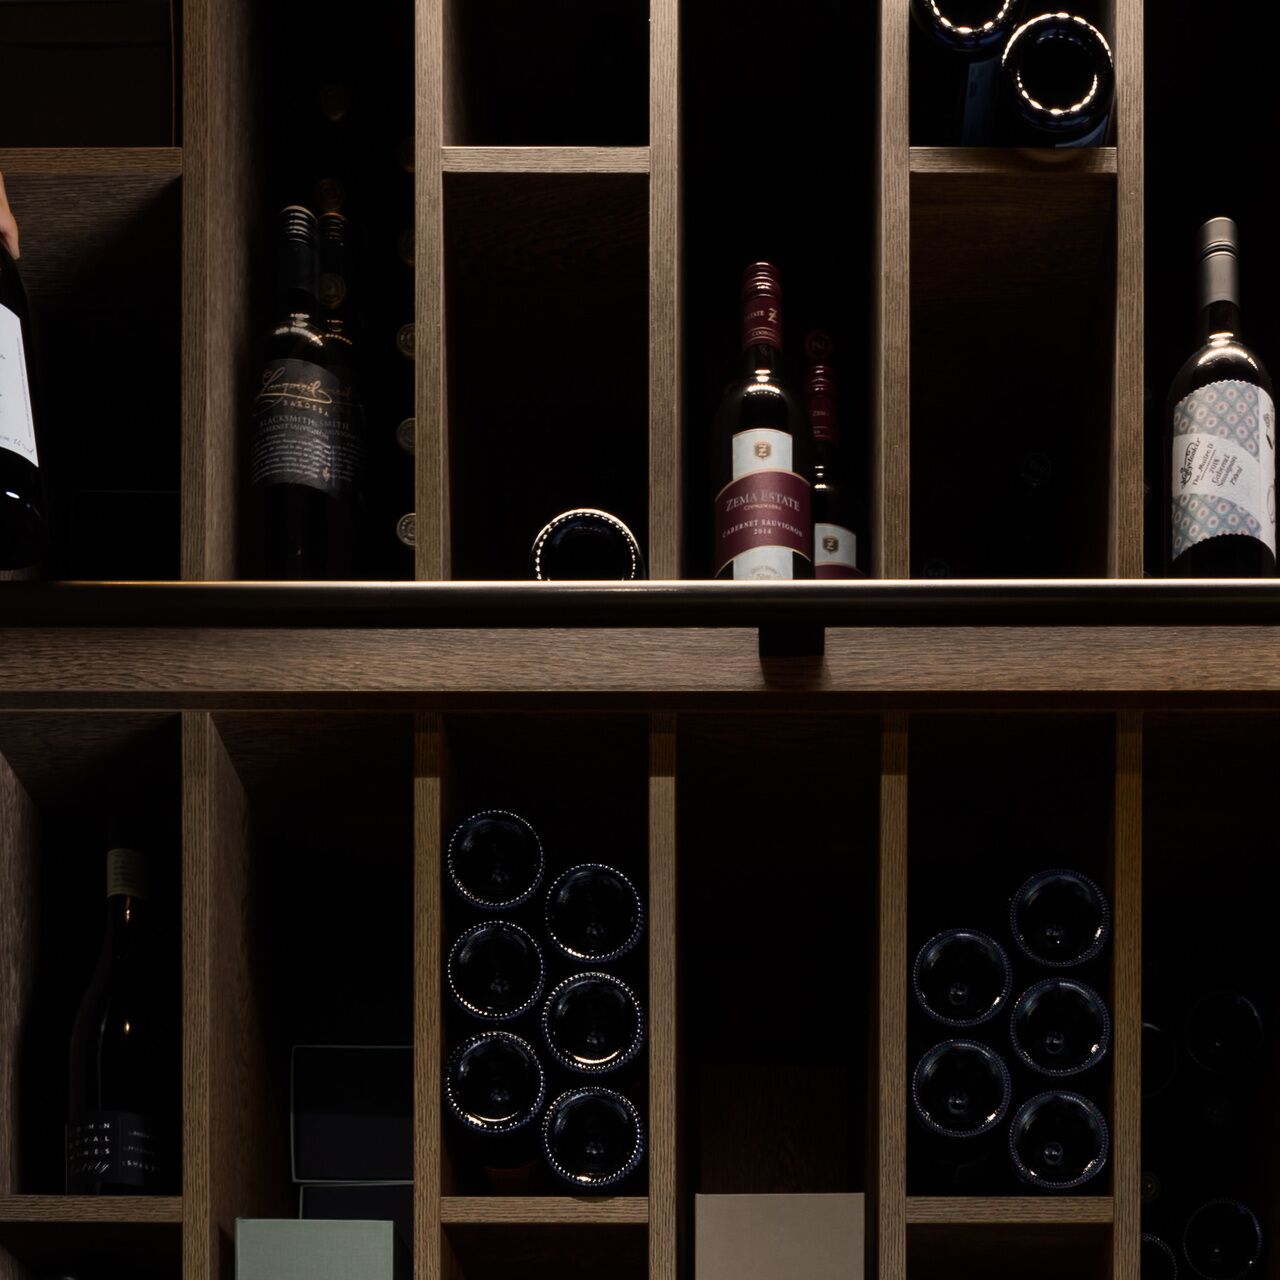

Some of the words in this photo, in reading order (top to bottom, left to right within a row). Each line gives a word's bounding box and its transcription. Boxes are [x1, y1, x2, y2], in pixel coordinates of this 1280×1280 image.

[726, 492, 759, 512] ZEMA
[761, 490, 800, 511] ESTATE
[722, 519, 758, 538] CABERNET
[761, 519, 803, 537] SAUVIGNON
